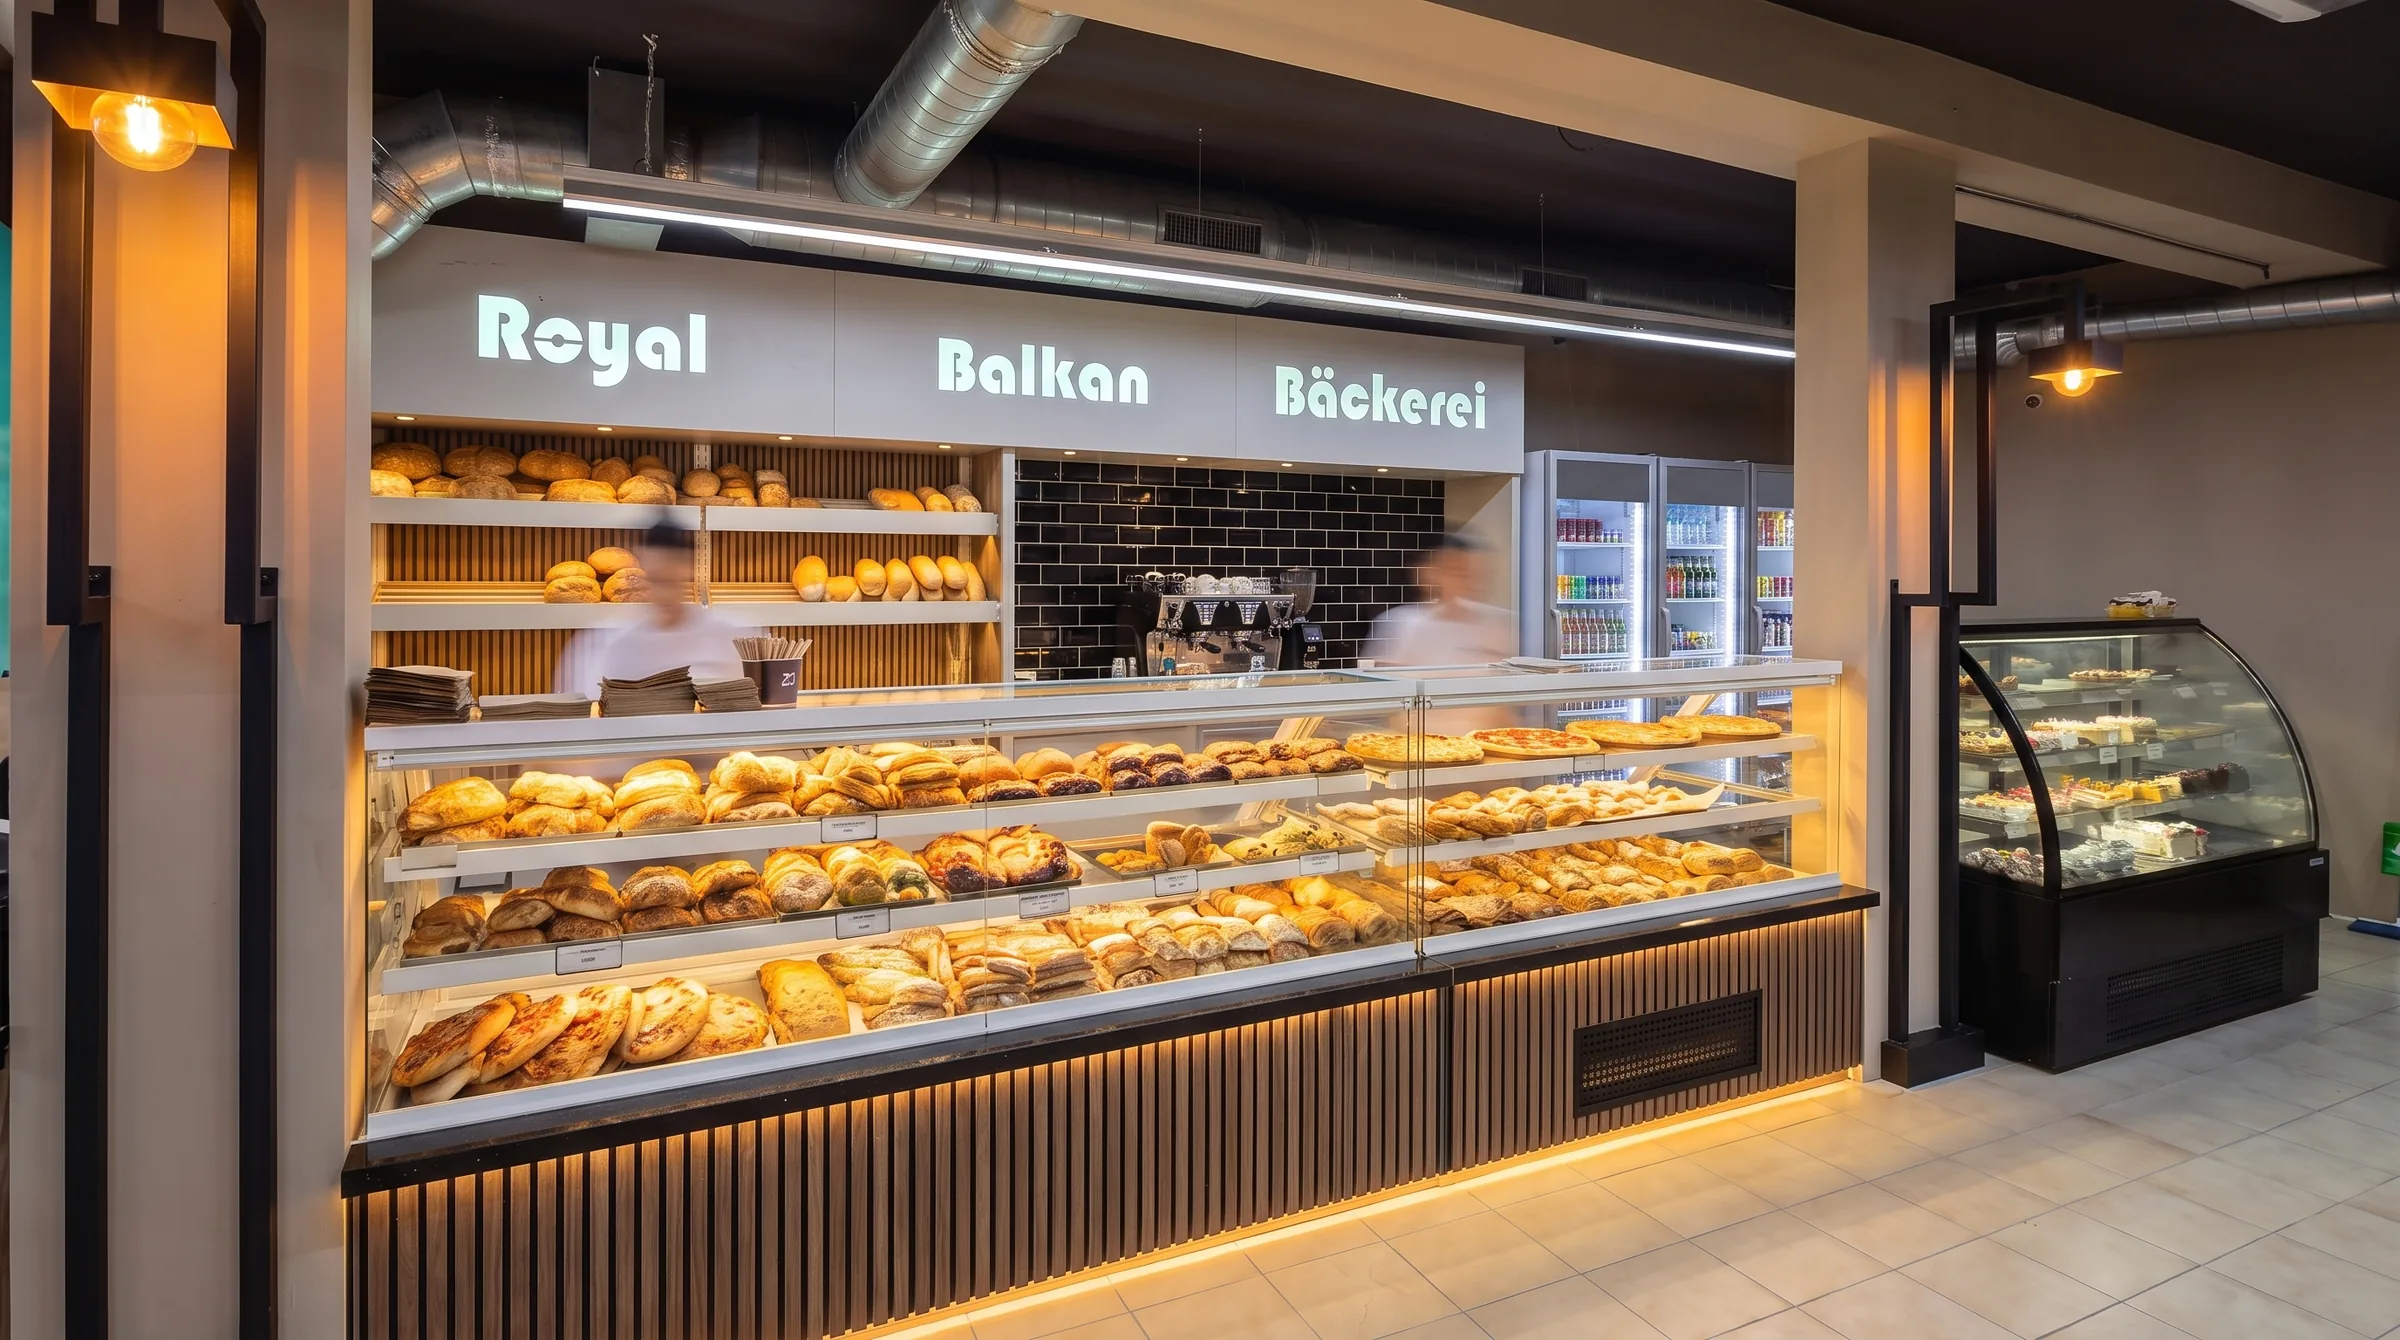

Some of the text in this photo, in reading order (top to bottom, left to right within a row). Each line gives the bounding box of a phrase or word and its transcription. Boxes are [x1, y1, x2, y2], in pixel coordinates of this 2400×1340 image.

[478, 294, 1486, 429] Royal Balkan Bäckerei
